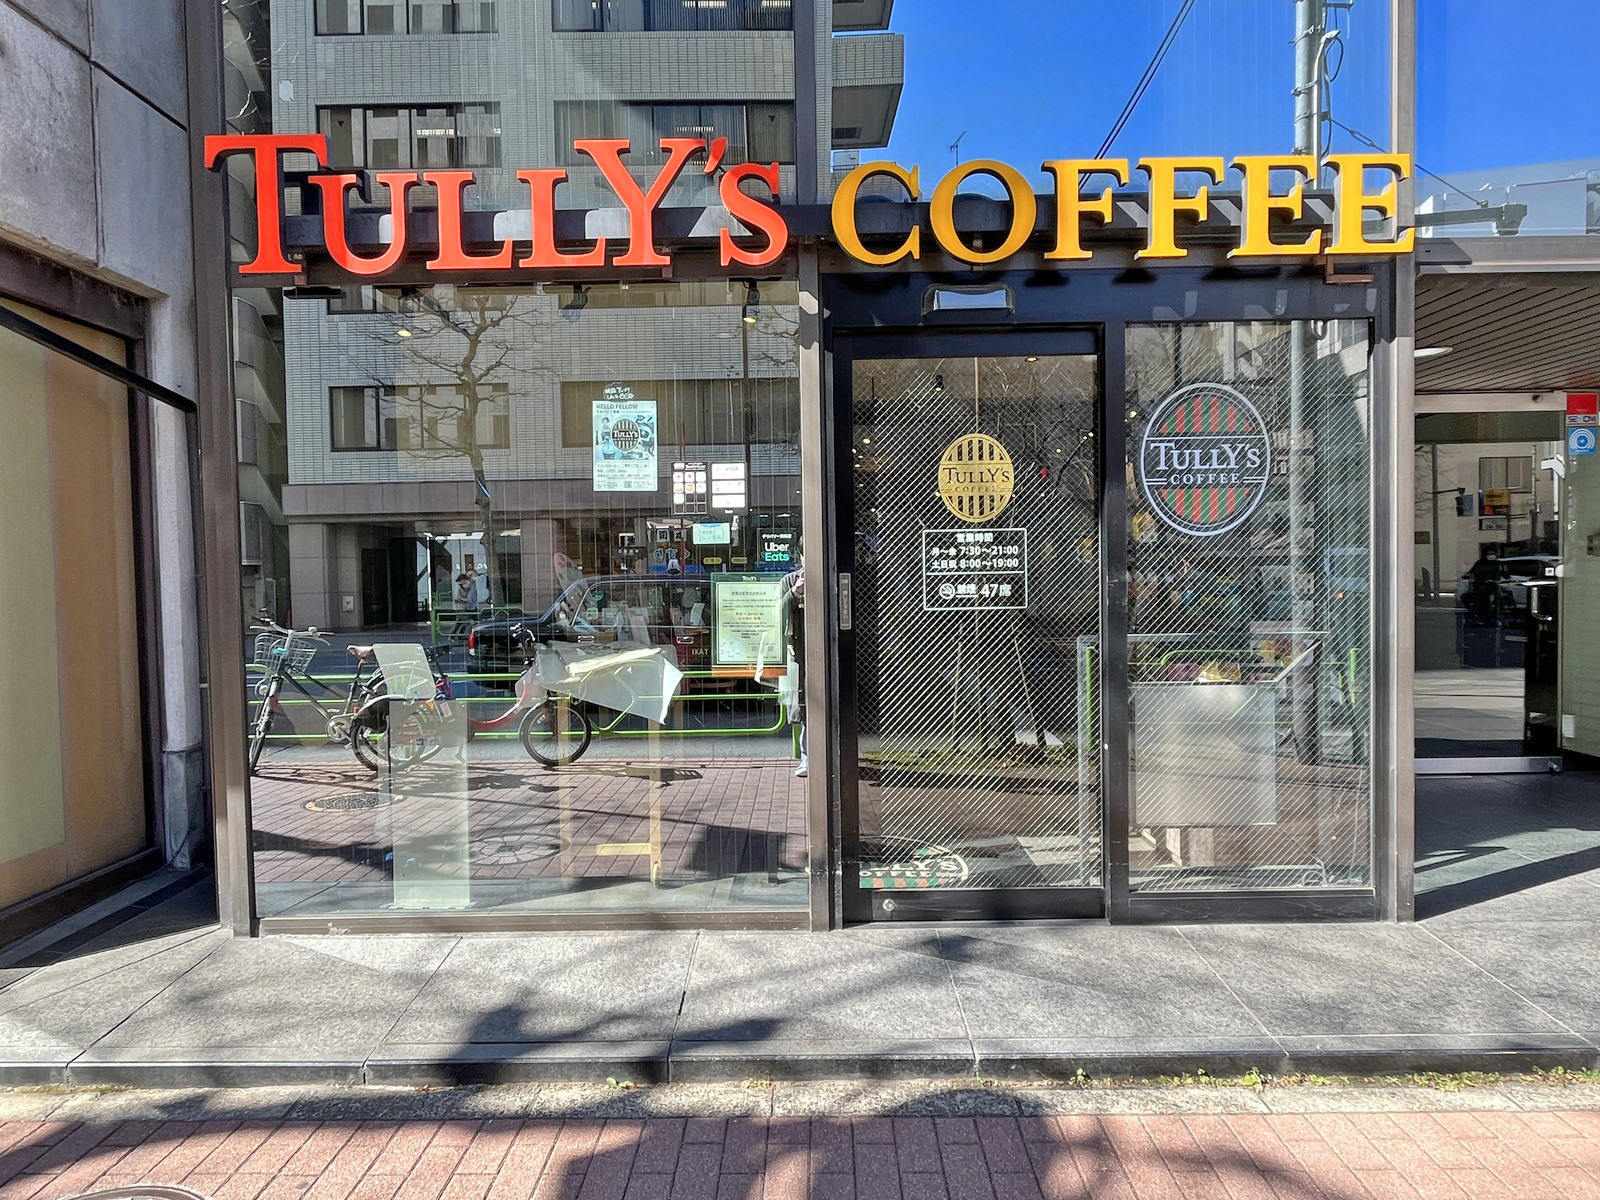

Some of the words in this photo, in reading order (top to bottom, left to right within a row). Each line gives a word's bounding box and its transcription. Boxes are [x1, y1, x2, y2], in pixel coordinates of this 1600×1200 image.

[204, 133, 788, 275] TULLY'S
[831, 153, 1415, 265] COFFEE
[1150, 442, 1261, 470] TULLY'S
[943, 467, 1010, 484] TULLY'S
[1170, 473, 1240, 485] COFFEE
[955, 485, 996, 493] COFFEE
[764, 542, 789, 552] Uber
[765, 552, 790, 561] Eats
[931, 560, 957, 569] 土日祝
